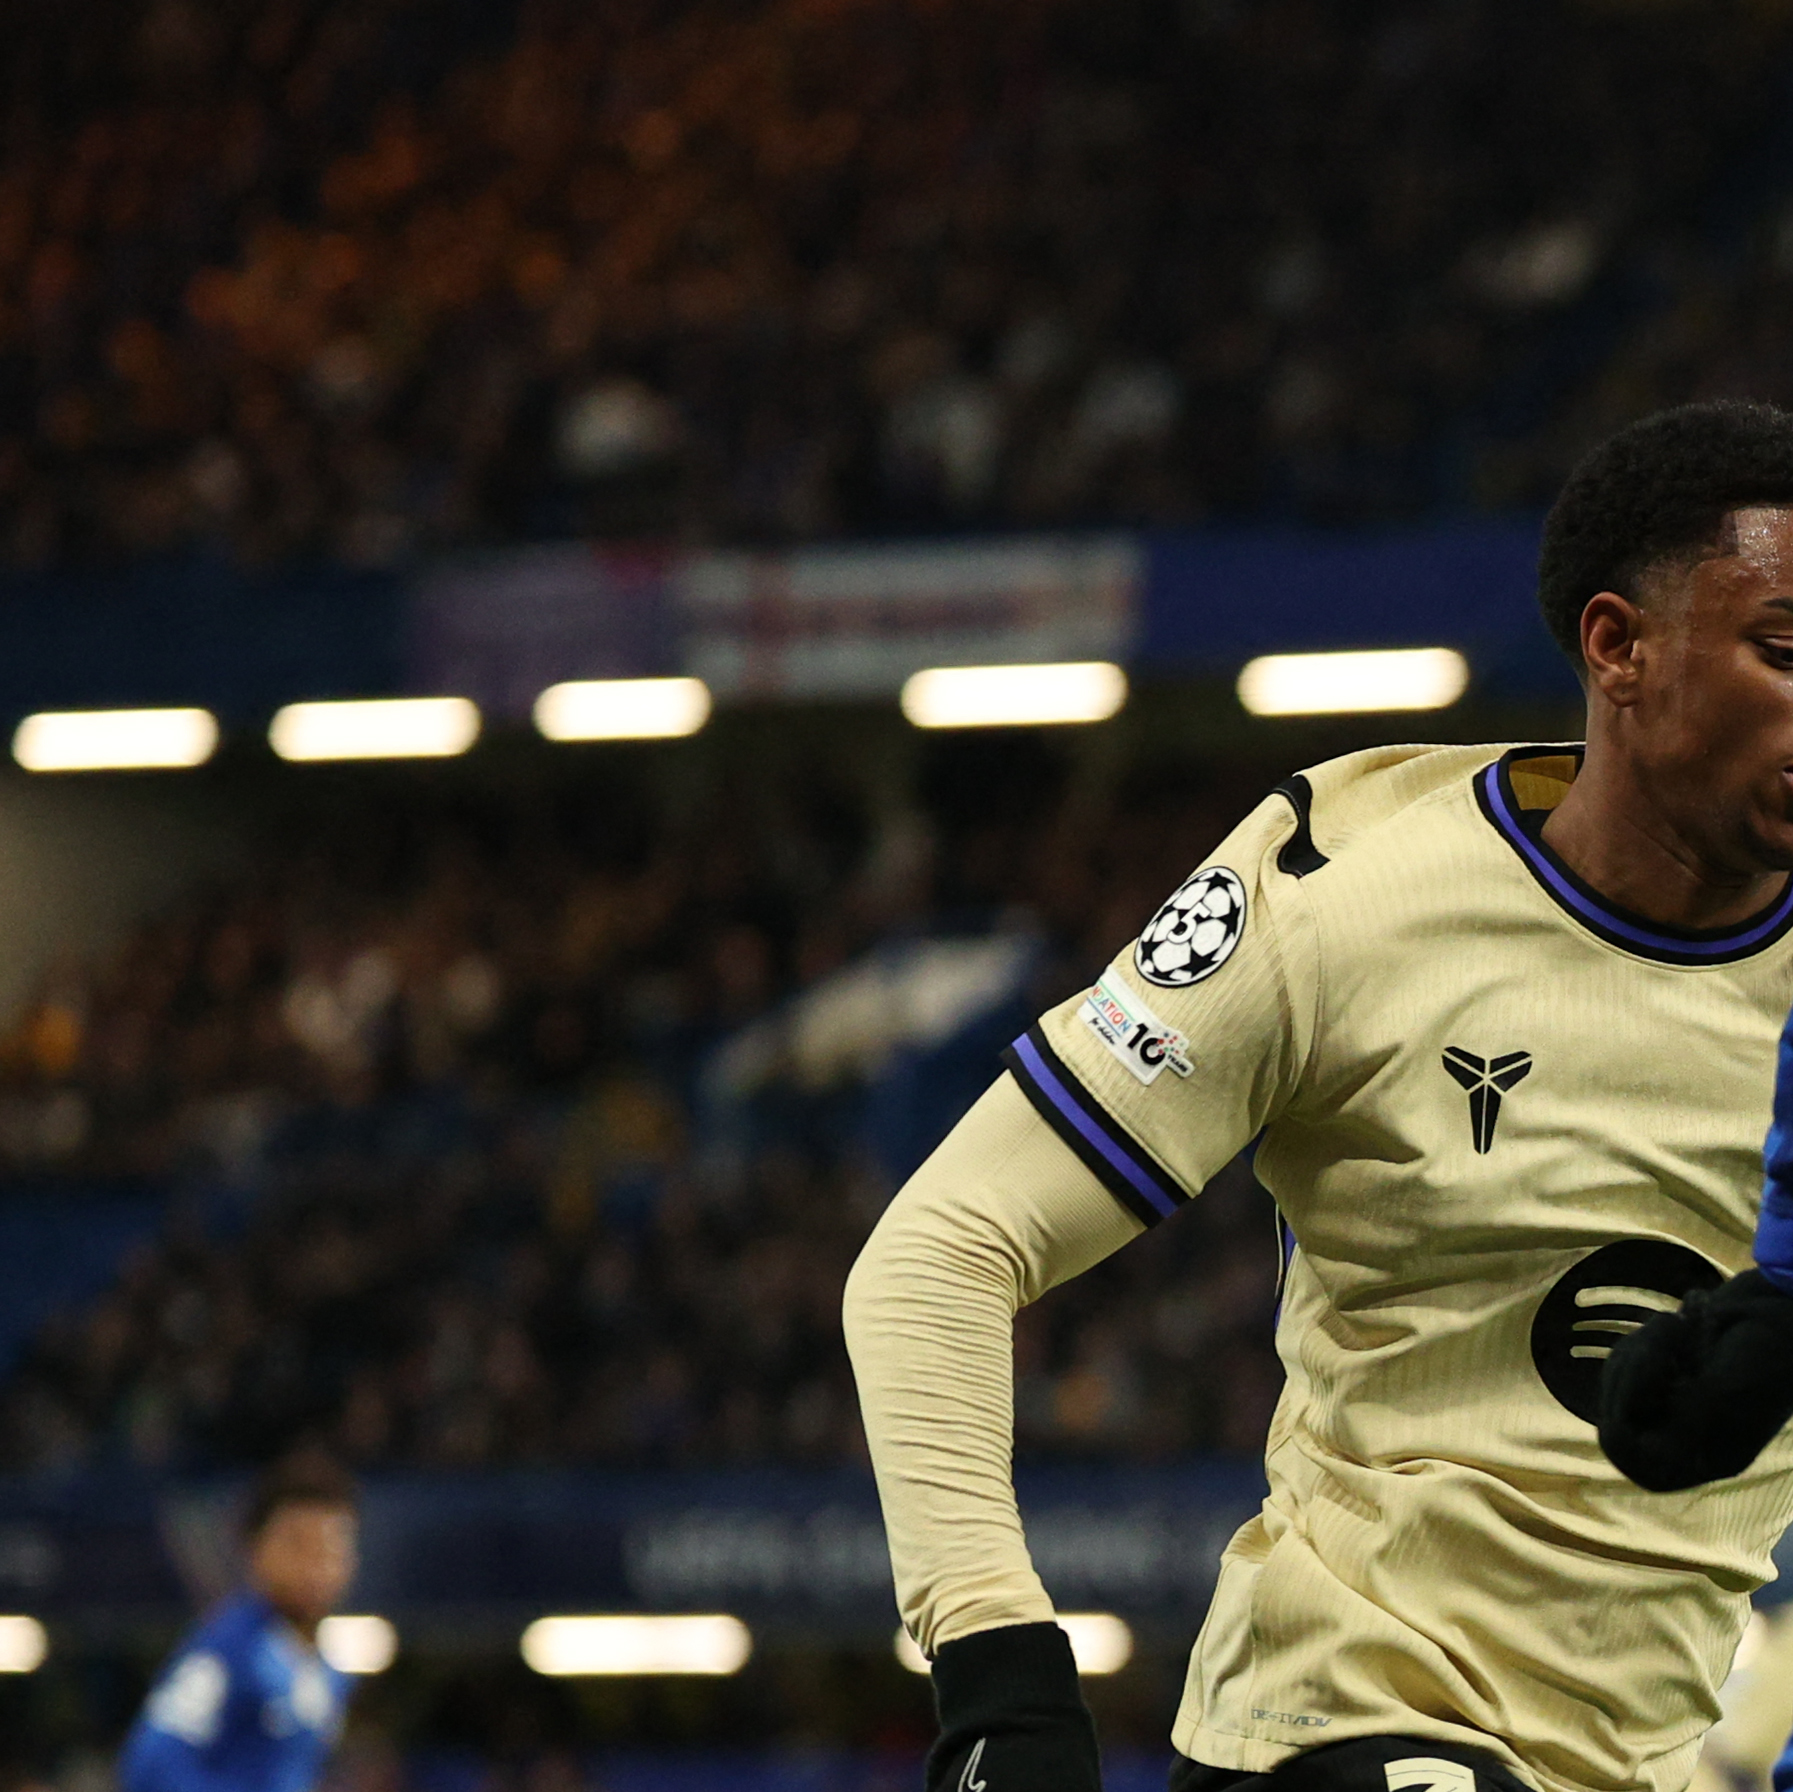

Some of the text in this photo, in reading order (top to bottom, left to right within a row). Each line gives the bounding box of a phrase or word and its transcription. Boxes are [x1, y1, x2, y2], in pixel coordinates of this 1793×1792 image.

[1166, 901, 1212, 945] 5
[1092, 986, 1131, 1033] NDATION
[1127, 1023, 1166, 1066] 10
